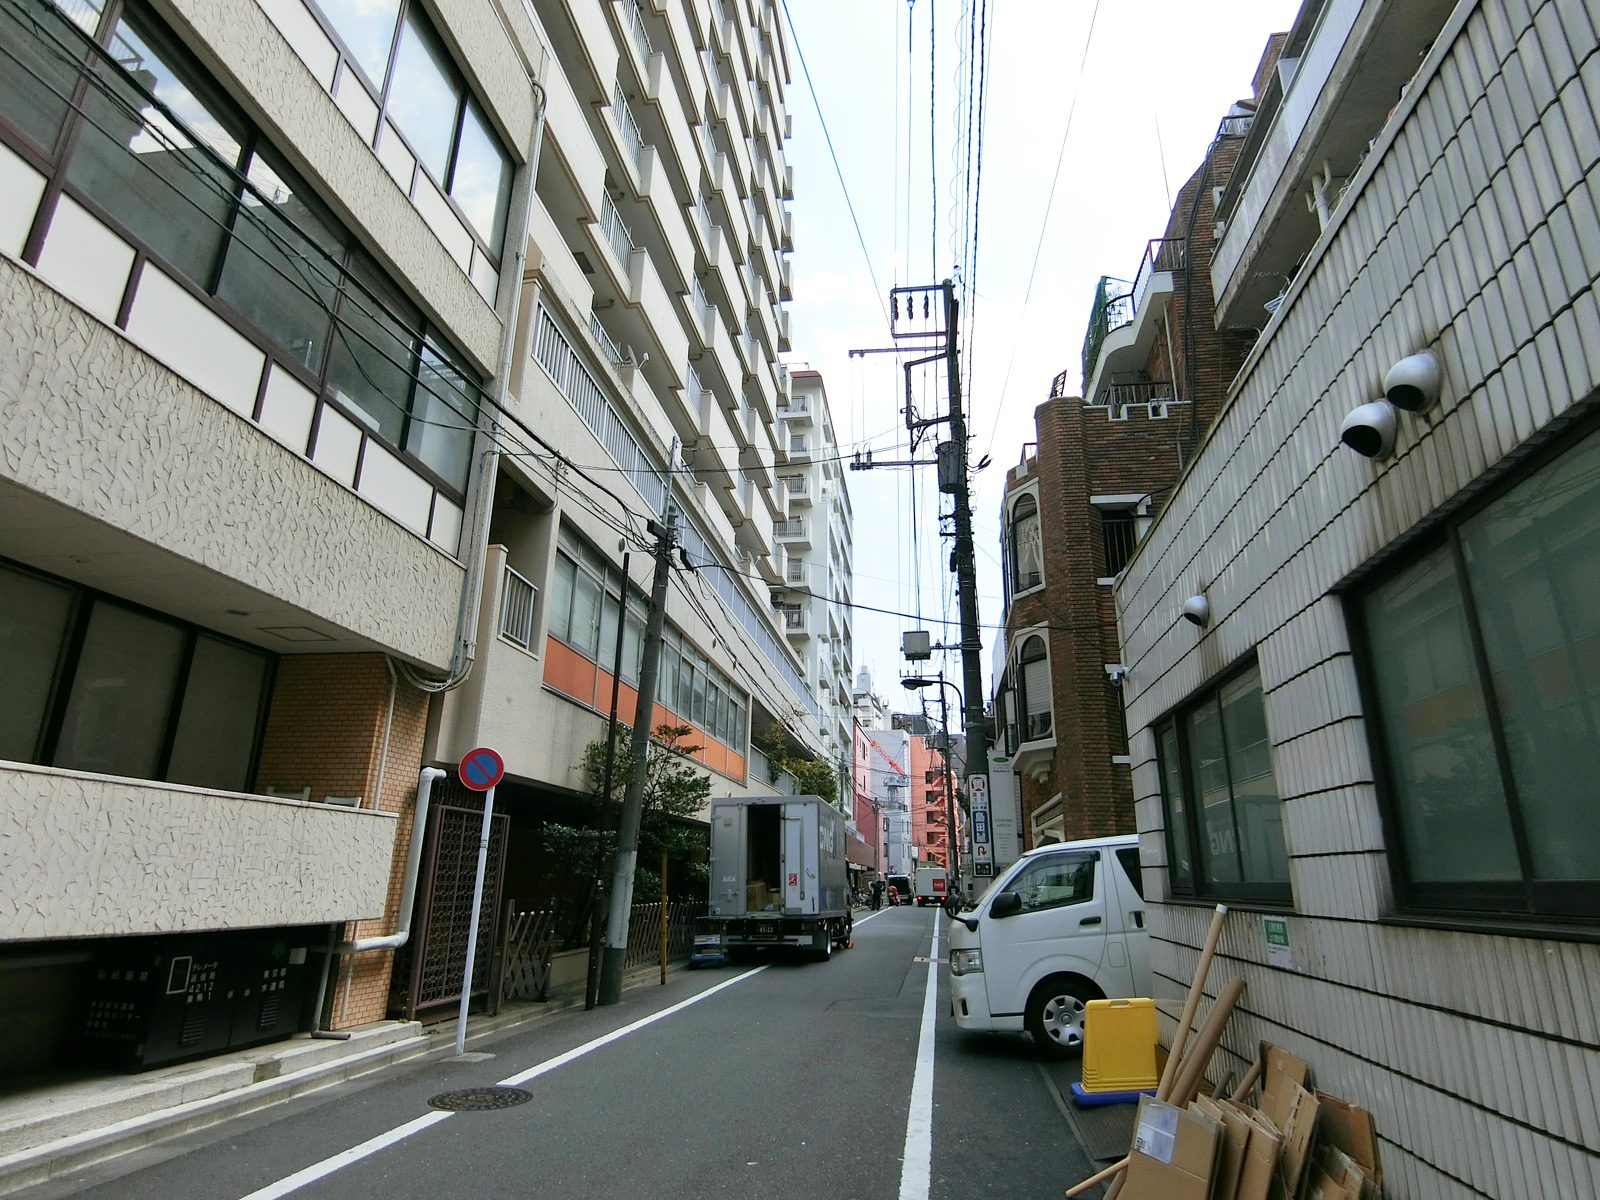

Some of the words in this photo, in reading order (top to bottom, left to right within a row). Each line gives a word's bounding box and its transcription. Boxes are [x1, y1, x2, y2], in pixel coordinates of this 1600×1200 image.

[263, 967, 288, 979] 東京都
[188, 981, 214, 993] 4212
